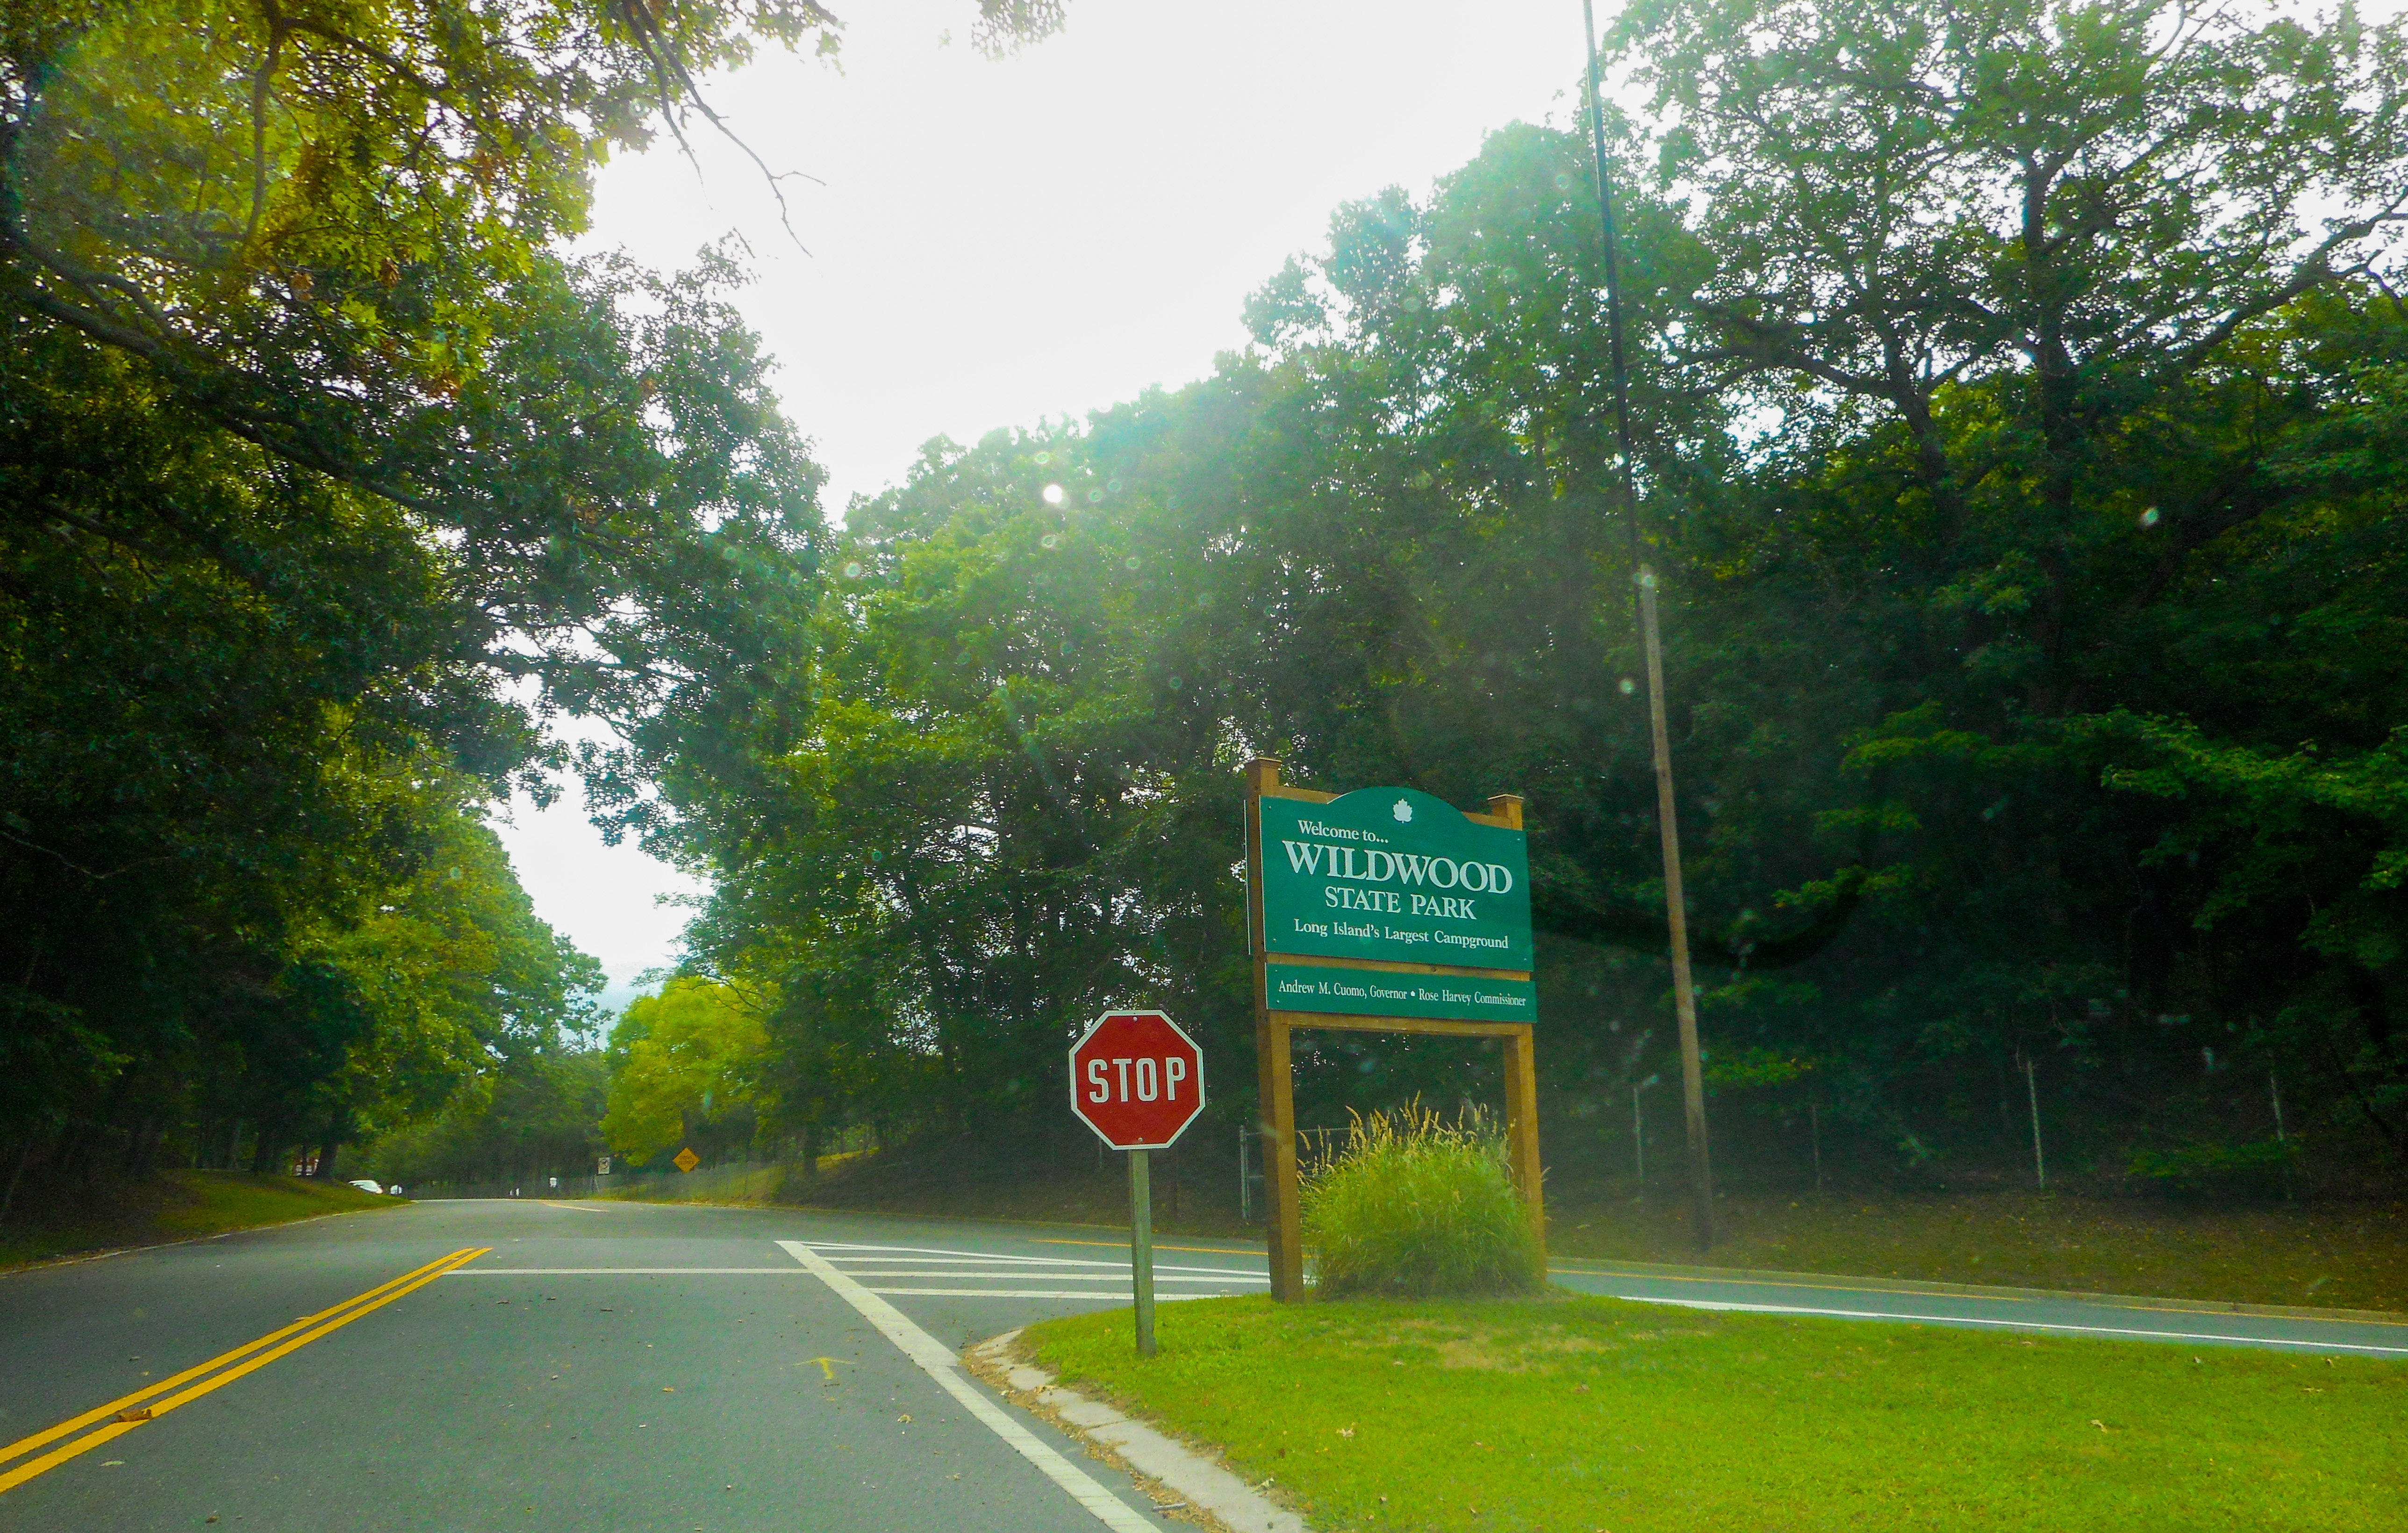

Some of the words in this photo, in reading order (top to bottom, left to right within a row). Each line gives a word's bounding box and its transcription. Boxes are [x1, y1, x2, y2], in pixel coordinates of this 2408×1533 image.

[1297, 820, 1359, 840] Welcome
[1362, 829, 1389, 843] to...
[1282, 840, 1512, 894] WILDWOOD
[1325, 886, 1401, 913] STATE
[1410, 894, 1477, 920] PARK
[1294, 918, 1328, 937] Long
[1333, 921, 1380, 938] Island's
[1384, 926, 1429, 944] Largest
[1434, 930, 1509, 949] Campground
[1278, 979, 1315, 994] Andrew
[1319, 981, 1331, 995] M.
[1333, 982, 1367, 999] Cuomo,
[1369, 985, 1407, 1000] Governor
[1418, 988, 1439, 1001] Rose
[1442, 989, 1471, 1006] Harvey
[1474, 991, 1526, 1007] Commissioner
[1088, 1057, 1186, 1103] STOP
